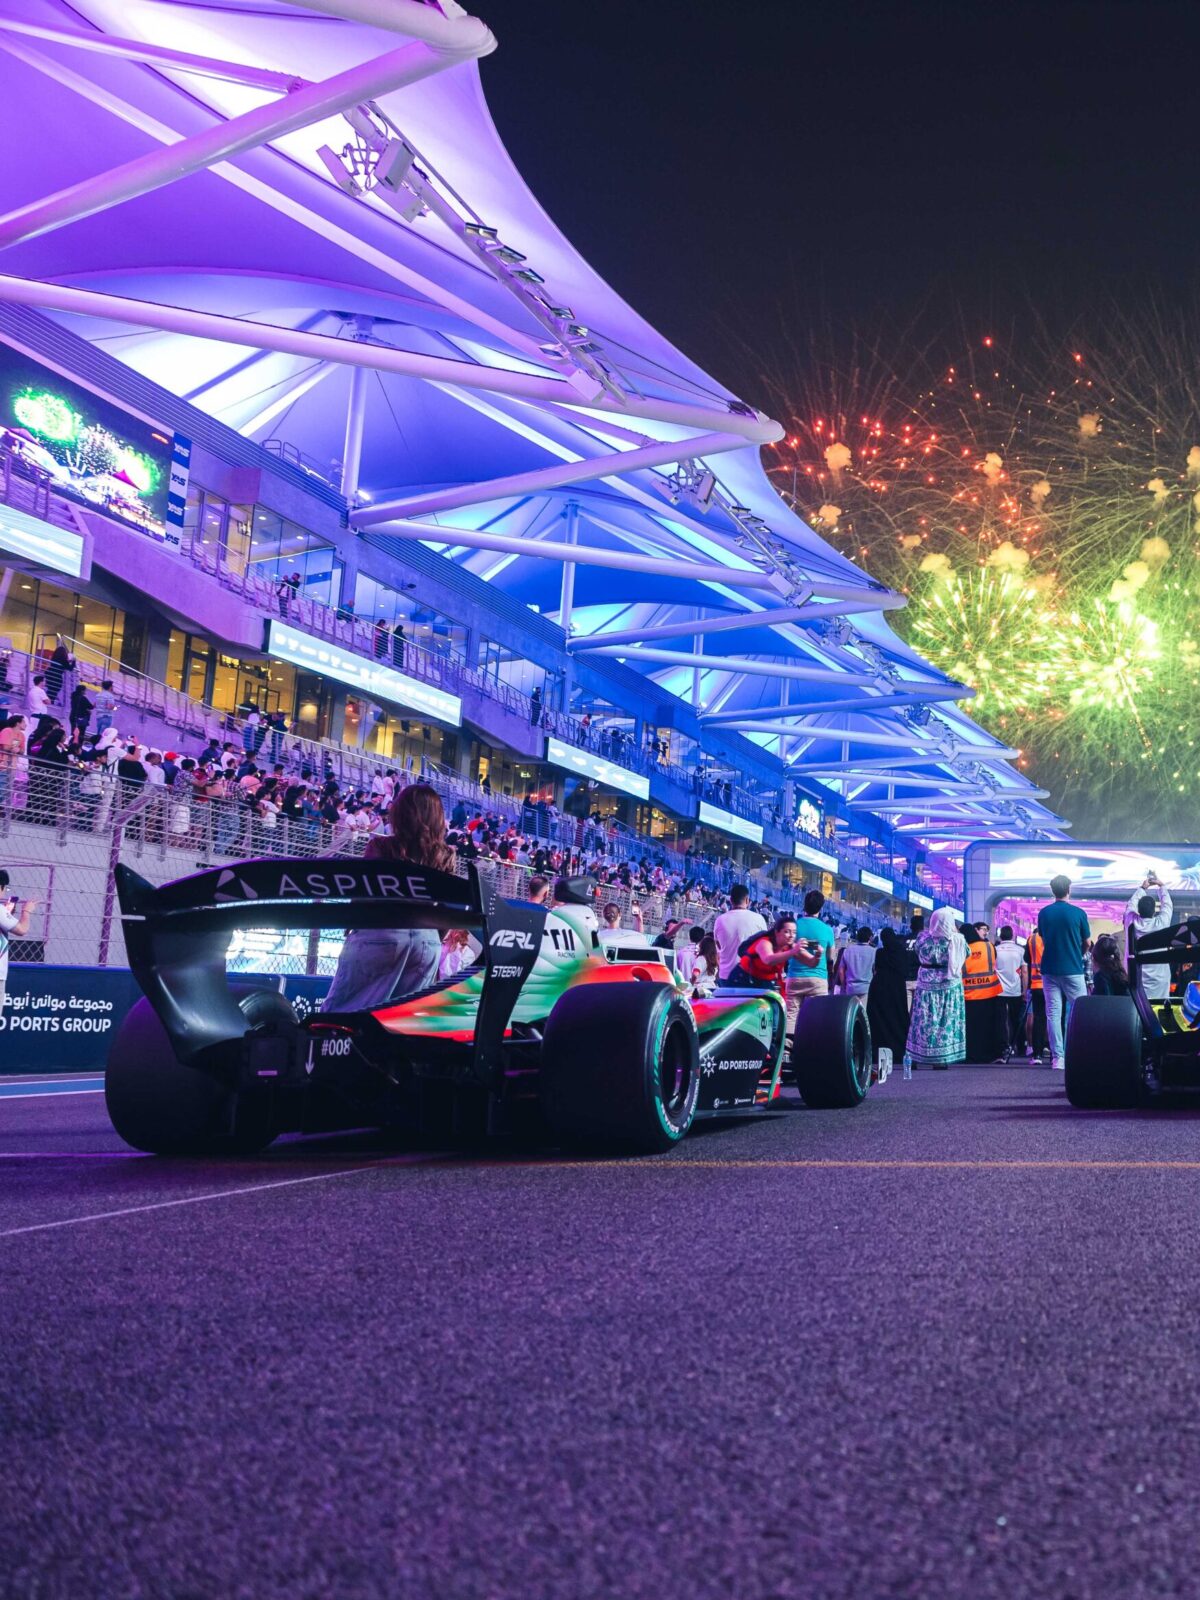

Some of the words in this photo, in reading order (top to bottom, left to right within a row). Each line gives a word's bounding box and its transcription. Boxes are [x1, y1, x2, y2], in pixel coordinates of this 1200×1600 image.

[278, 873, 432, 899] ASPIRE
[489, 929, 536, 950] A2RL
[965, 977, 991, 985] MEDIA
[9, 1016, 60, 1031] PORTS
[62, 1017, 112, 1032] GROUP
[321, 1038, 351, 1056] #008
[718, 1060, 729, 1070] AD
[730, 1060, 748, 1070] PORTS
[748, 1060, 763, 1070] GROUP
